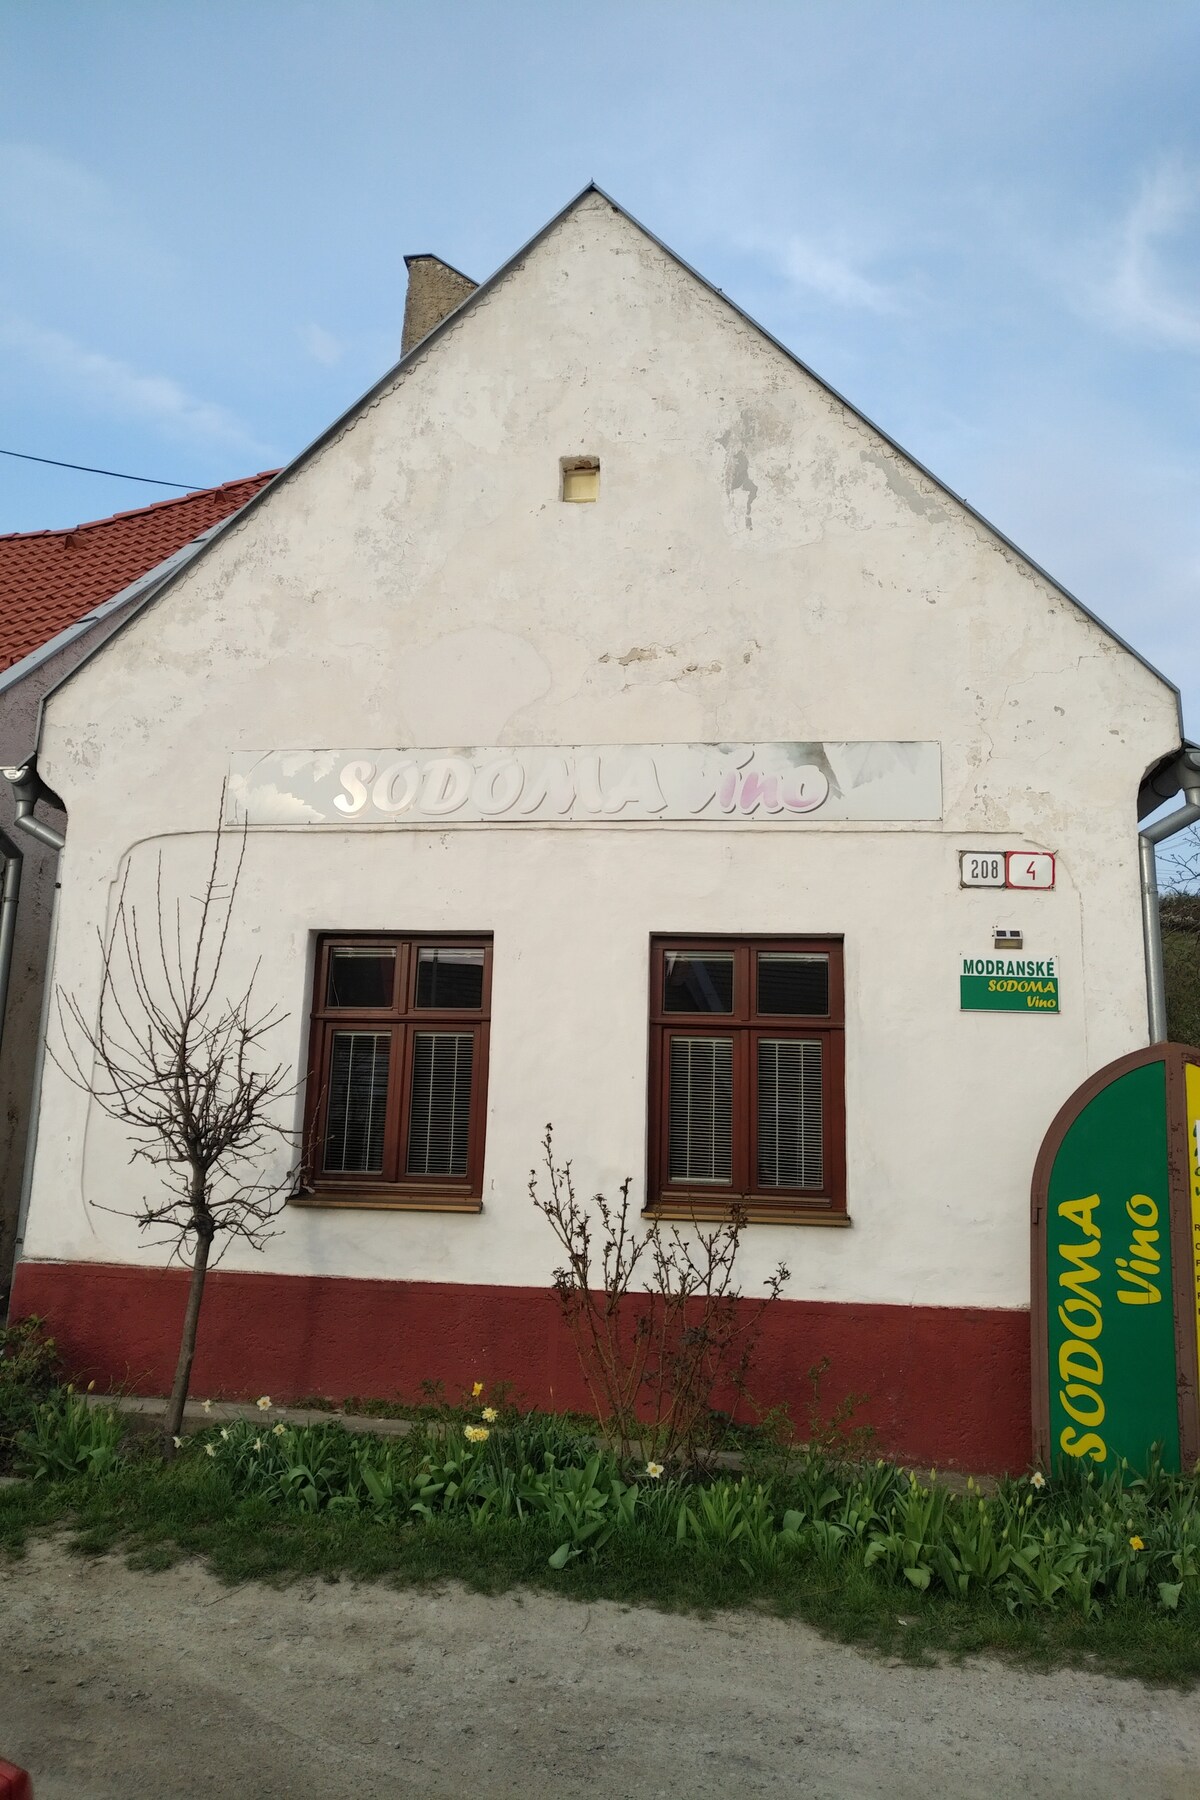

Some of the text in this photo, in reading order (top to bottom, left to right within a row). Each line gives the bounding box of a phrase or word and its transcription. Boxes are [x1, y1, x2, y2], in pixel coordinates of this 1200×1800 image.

[332, 758, 667, 818] SODOMA
[971, 859, 1036, 880] 208 4
[963, 957, 1055, 976] MODRANSKÉ
[988, 979, 1056, 993] SODOMA
[1026, 995, 1056, 1008] Vino
[1114, 1193, 1162, 1305] Vino
[1057, 1193, 1107, 1463] SODOMA
